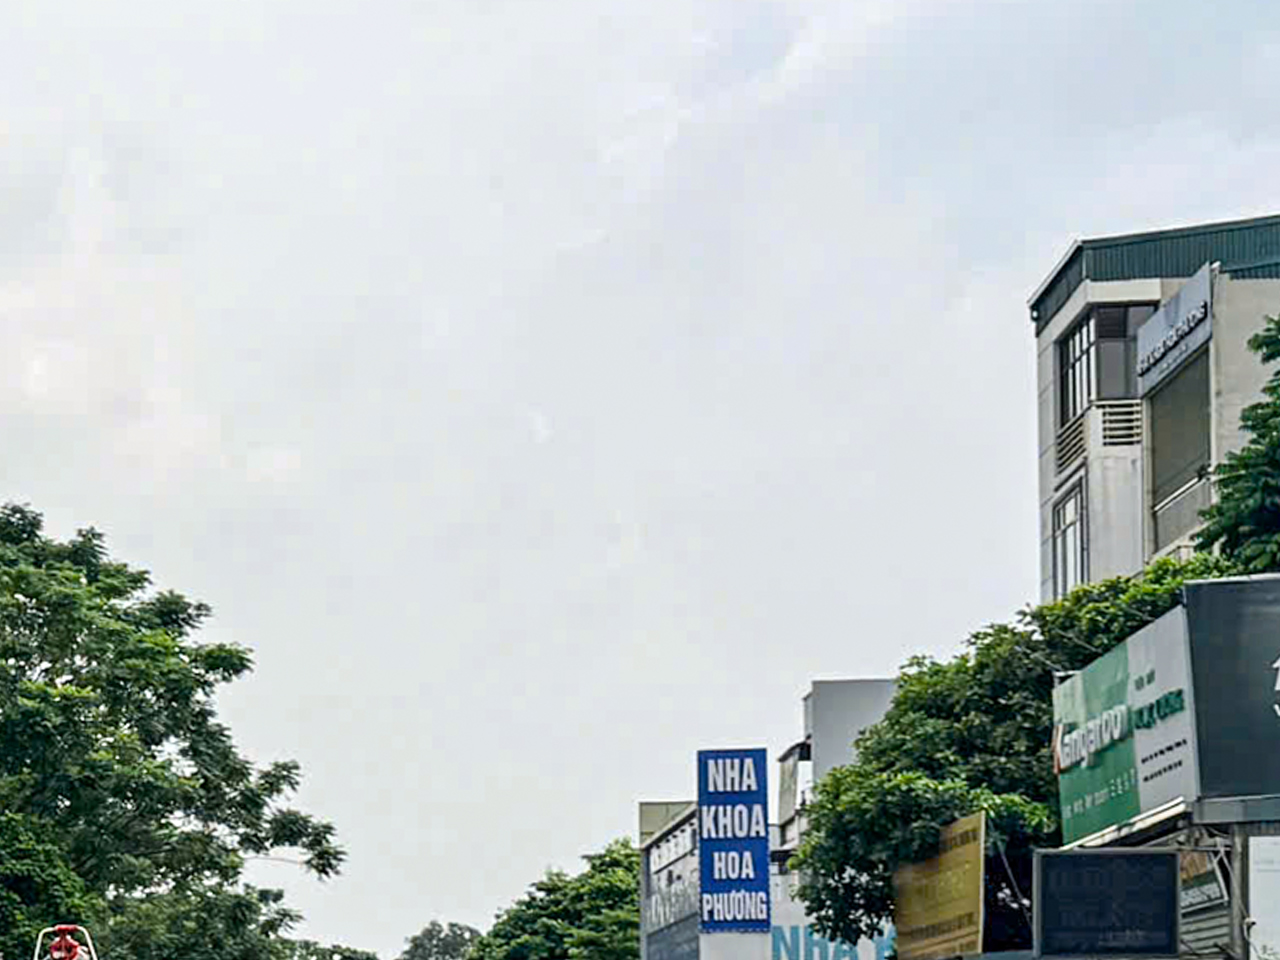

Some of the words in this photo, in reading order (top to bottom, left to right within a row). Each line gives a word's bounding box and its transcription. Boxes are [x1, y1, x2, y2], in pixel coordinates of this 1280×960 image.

[707, 758, 758, 793] NHA
[701, 803, 766, 840] KHOA
[713, 851, 754, 880] HOA
